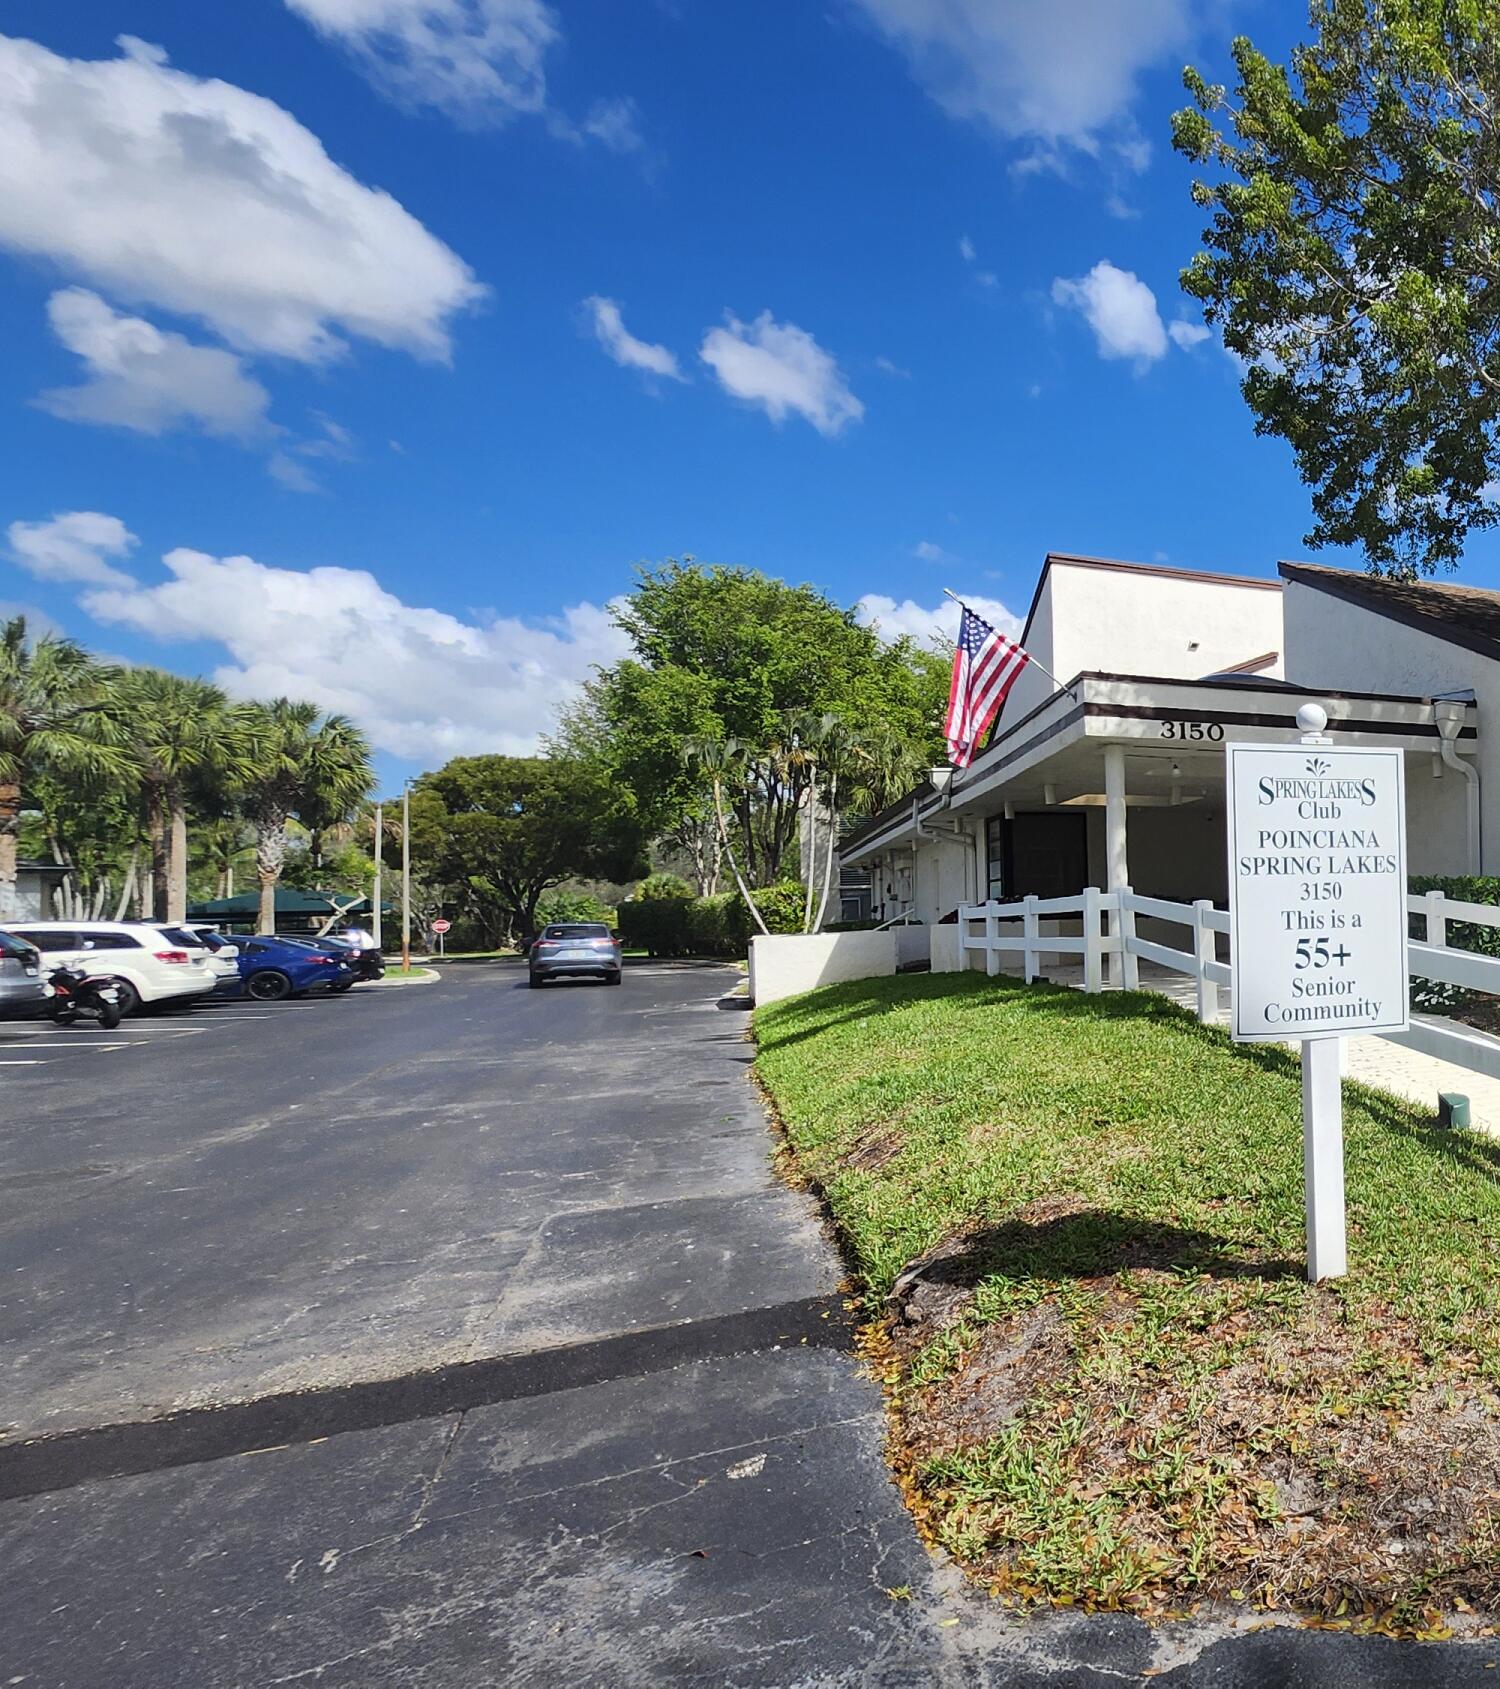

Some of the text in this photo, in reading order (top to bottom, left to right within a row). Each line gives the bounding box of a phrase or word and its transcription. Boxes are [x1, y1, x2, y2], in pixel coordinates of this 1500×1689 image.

[1161, 721, 1224, 741] 3150
[1259, 776, 1317, 805] SPRING
[1298, 800, 1341, 819] Club
[1258, 829, 1380, 849] POINCIANA
[1240, 854, 1396, 876] SPRING LAKES
[1300, 881, 1342, 901] 3150
[1281, 909, 1362, 930] This is a
[1295, 937, 1351, 969] 55+
[1292, 976, 1356, 998] Senior
[1264, 997, 1381, 1023] Community
